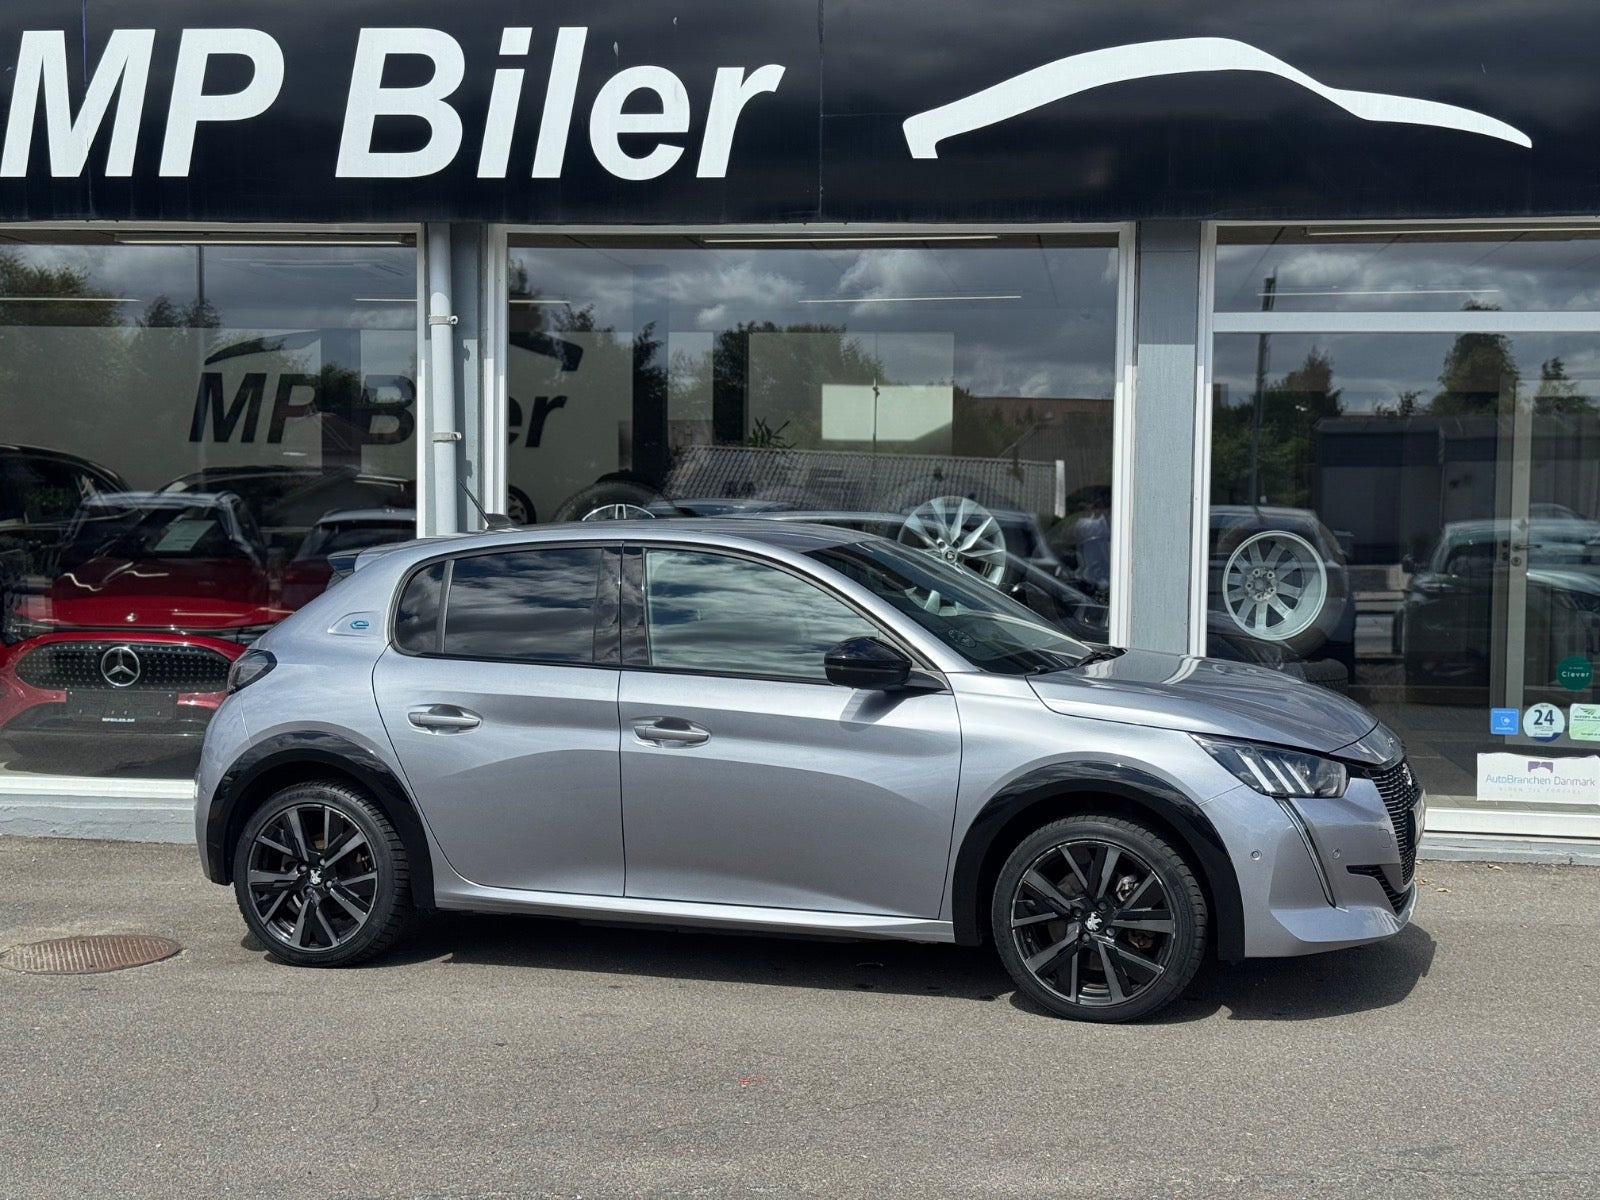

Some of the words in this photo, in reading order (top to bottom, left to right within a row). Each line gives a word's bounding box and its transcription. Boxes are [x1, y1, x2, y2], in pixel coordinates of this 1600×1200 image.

[0, 28, 284, 177] MP
[335, 27, 786, 180] Biler
[189, 372, 317, 443] MP
[1533, 709, 1555, 725] 24
[1486, 774, 1551, 785] AutoBranchen
[1553, 776, 1596, 787] Danmark
